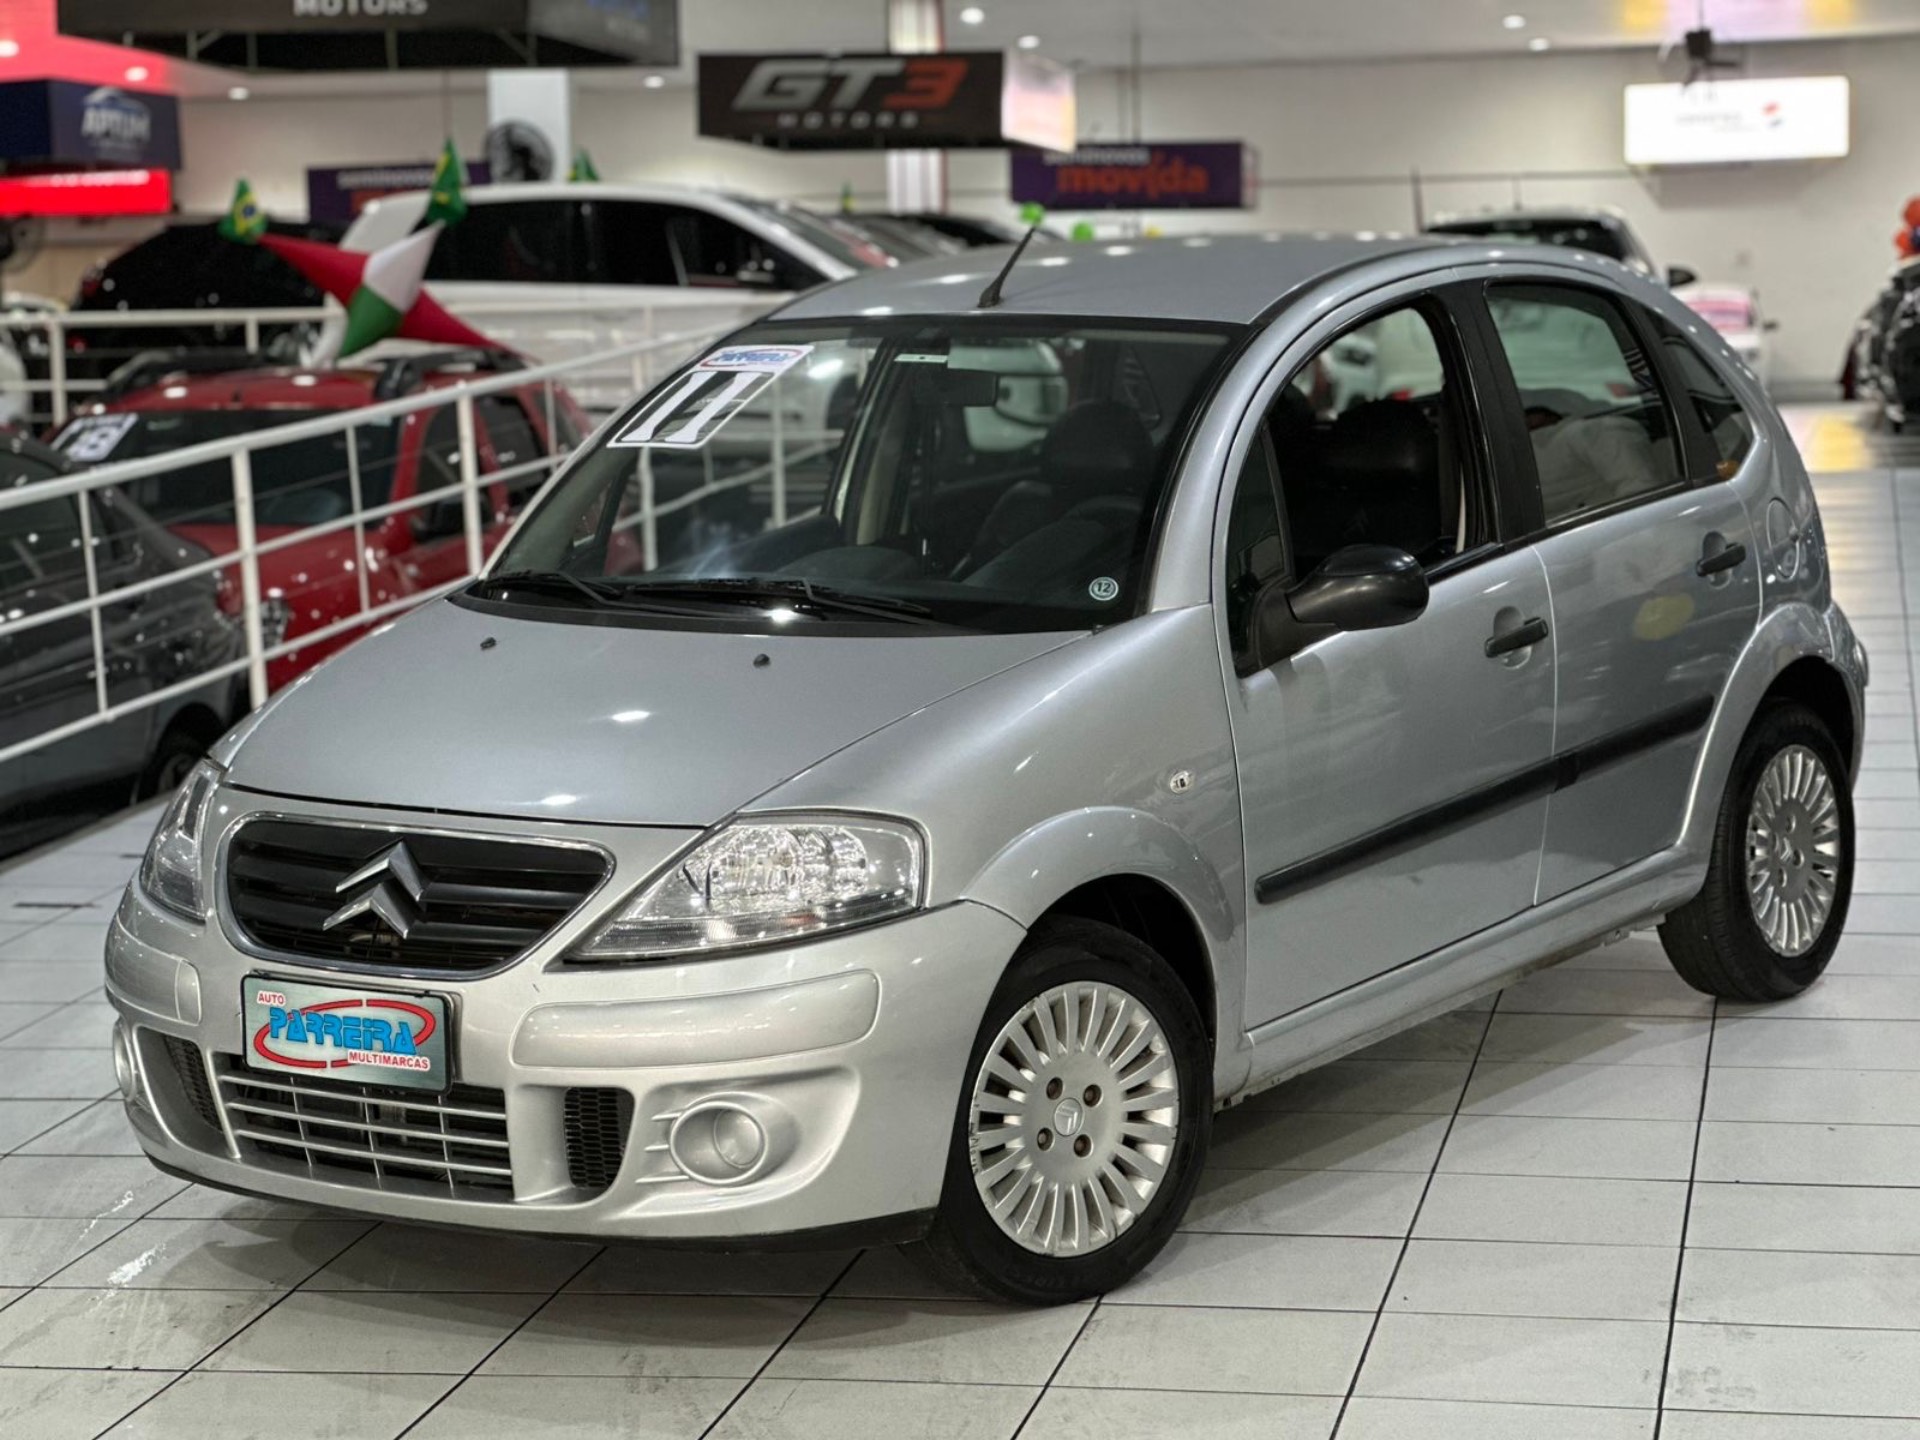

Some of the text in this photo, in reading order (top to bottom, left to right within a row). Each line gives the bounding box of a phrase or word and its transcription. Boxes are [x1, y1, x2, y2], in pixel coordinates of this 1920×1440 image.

[731, 57, 968, 111] GT3
[777, 111, 919, 129] MOTORS
[1056, 153, 1210, 199] movida
[1097, 582, 1111, 593] 12
[258, 992, 285, 1005] AUTO
[269, 1006, 416, 1056] PARREIRA
[349, 1051, 430, 1069] MULTIMARCAS
